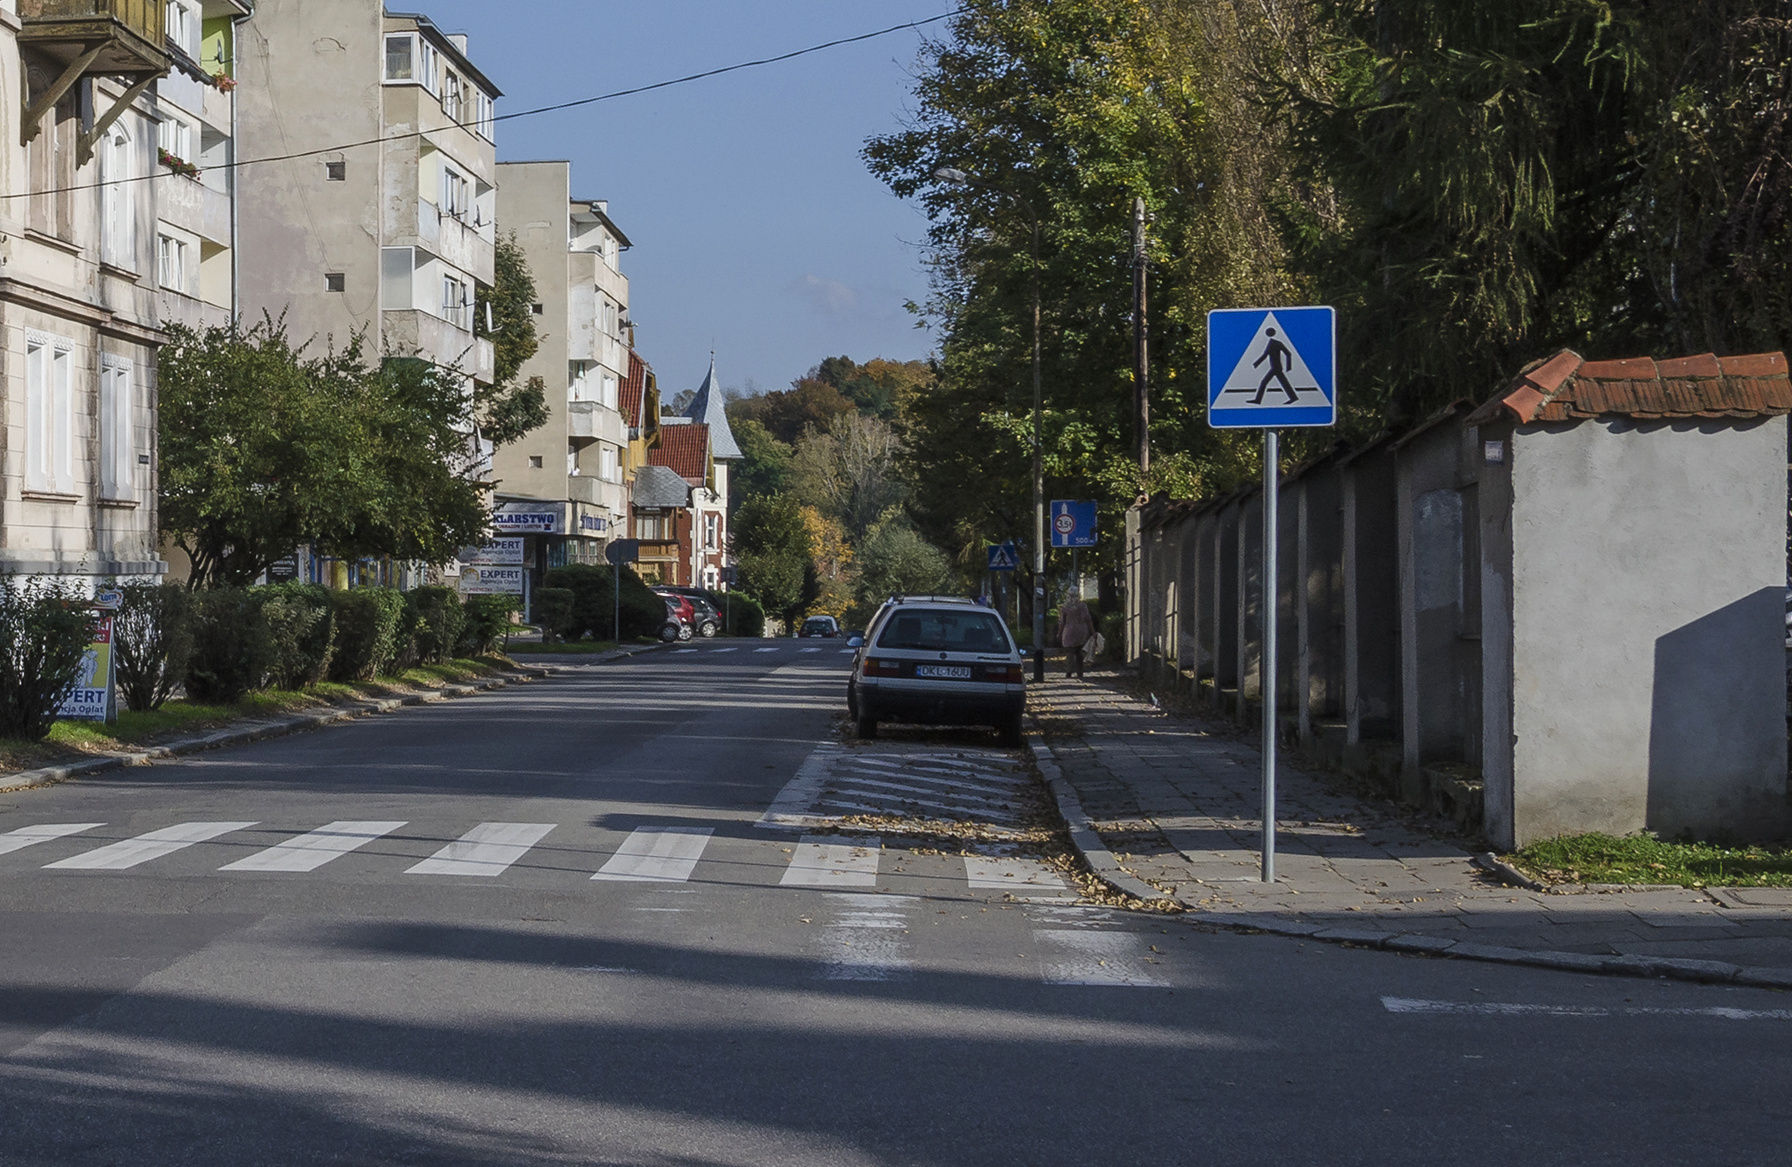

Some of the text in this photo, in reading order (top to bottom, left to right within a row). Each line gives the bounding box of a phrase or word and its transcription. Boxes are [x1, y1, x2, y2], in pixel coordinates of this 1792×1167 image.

[493, 514, 555, 524] KLARSTWO
[480, 570, 520, 579] EXPERT
[66, 690, 105, 703] PERT
